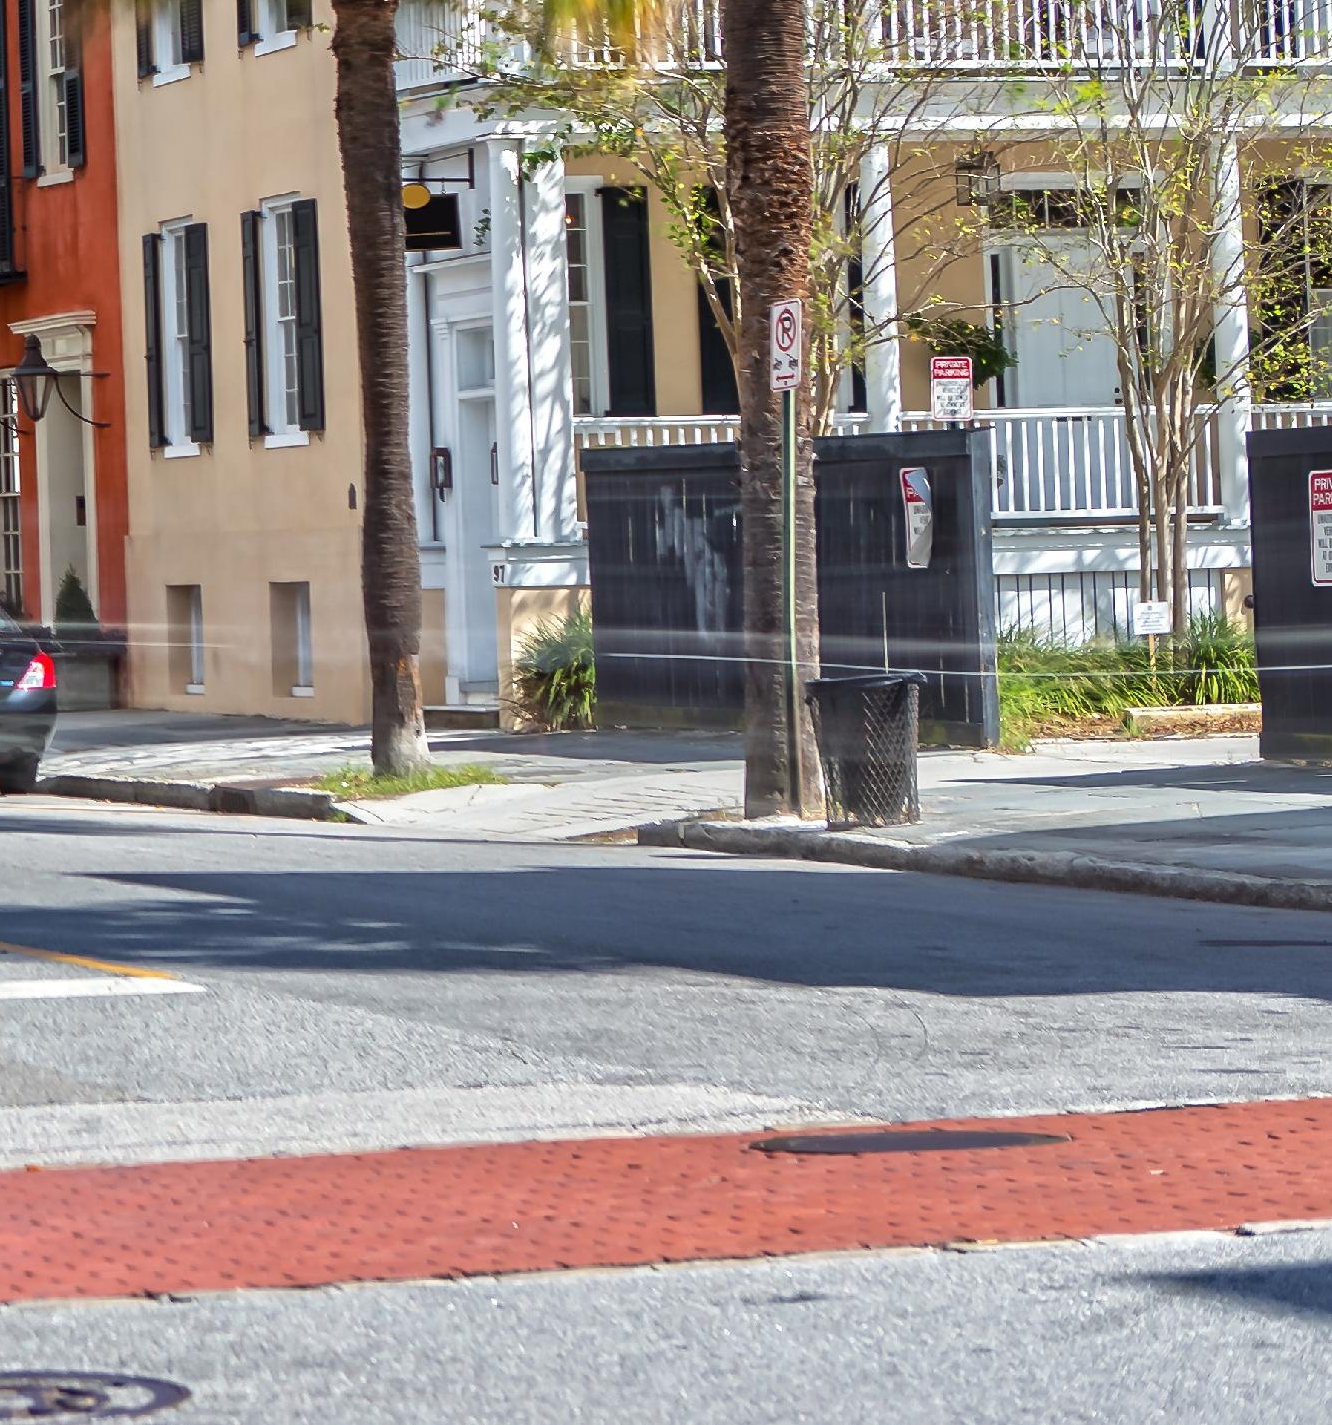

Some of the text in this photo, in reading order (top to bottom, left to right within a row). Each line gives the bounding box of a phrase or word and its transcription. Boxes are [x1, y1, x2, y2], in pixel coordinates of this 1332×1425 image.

[934, 360, 968, 368] PRIVATE
[934, 368, 970, 377] PARKING
[493, 565, 505, 584] 97
